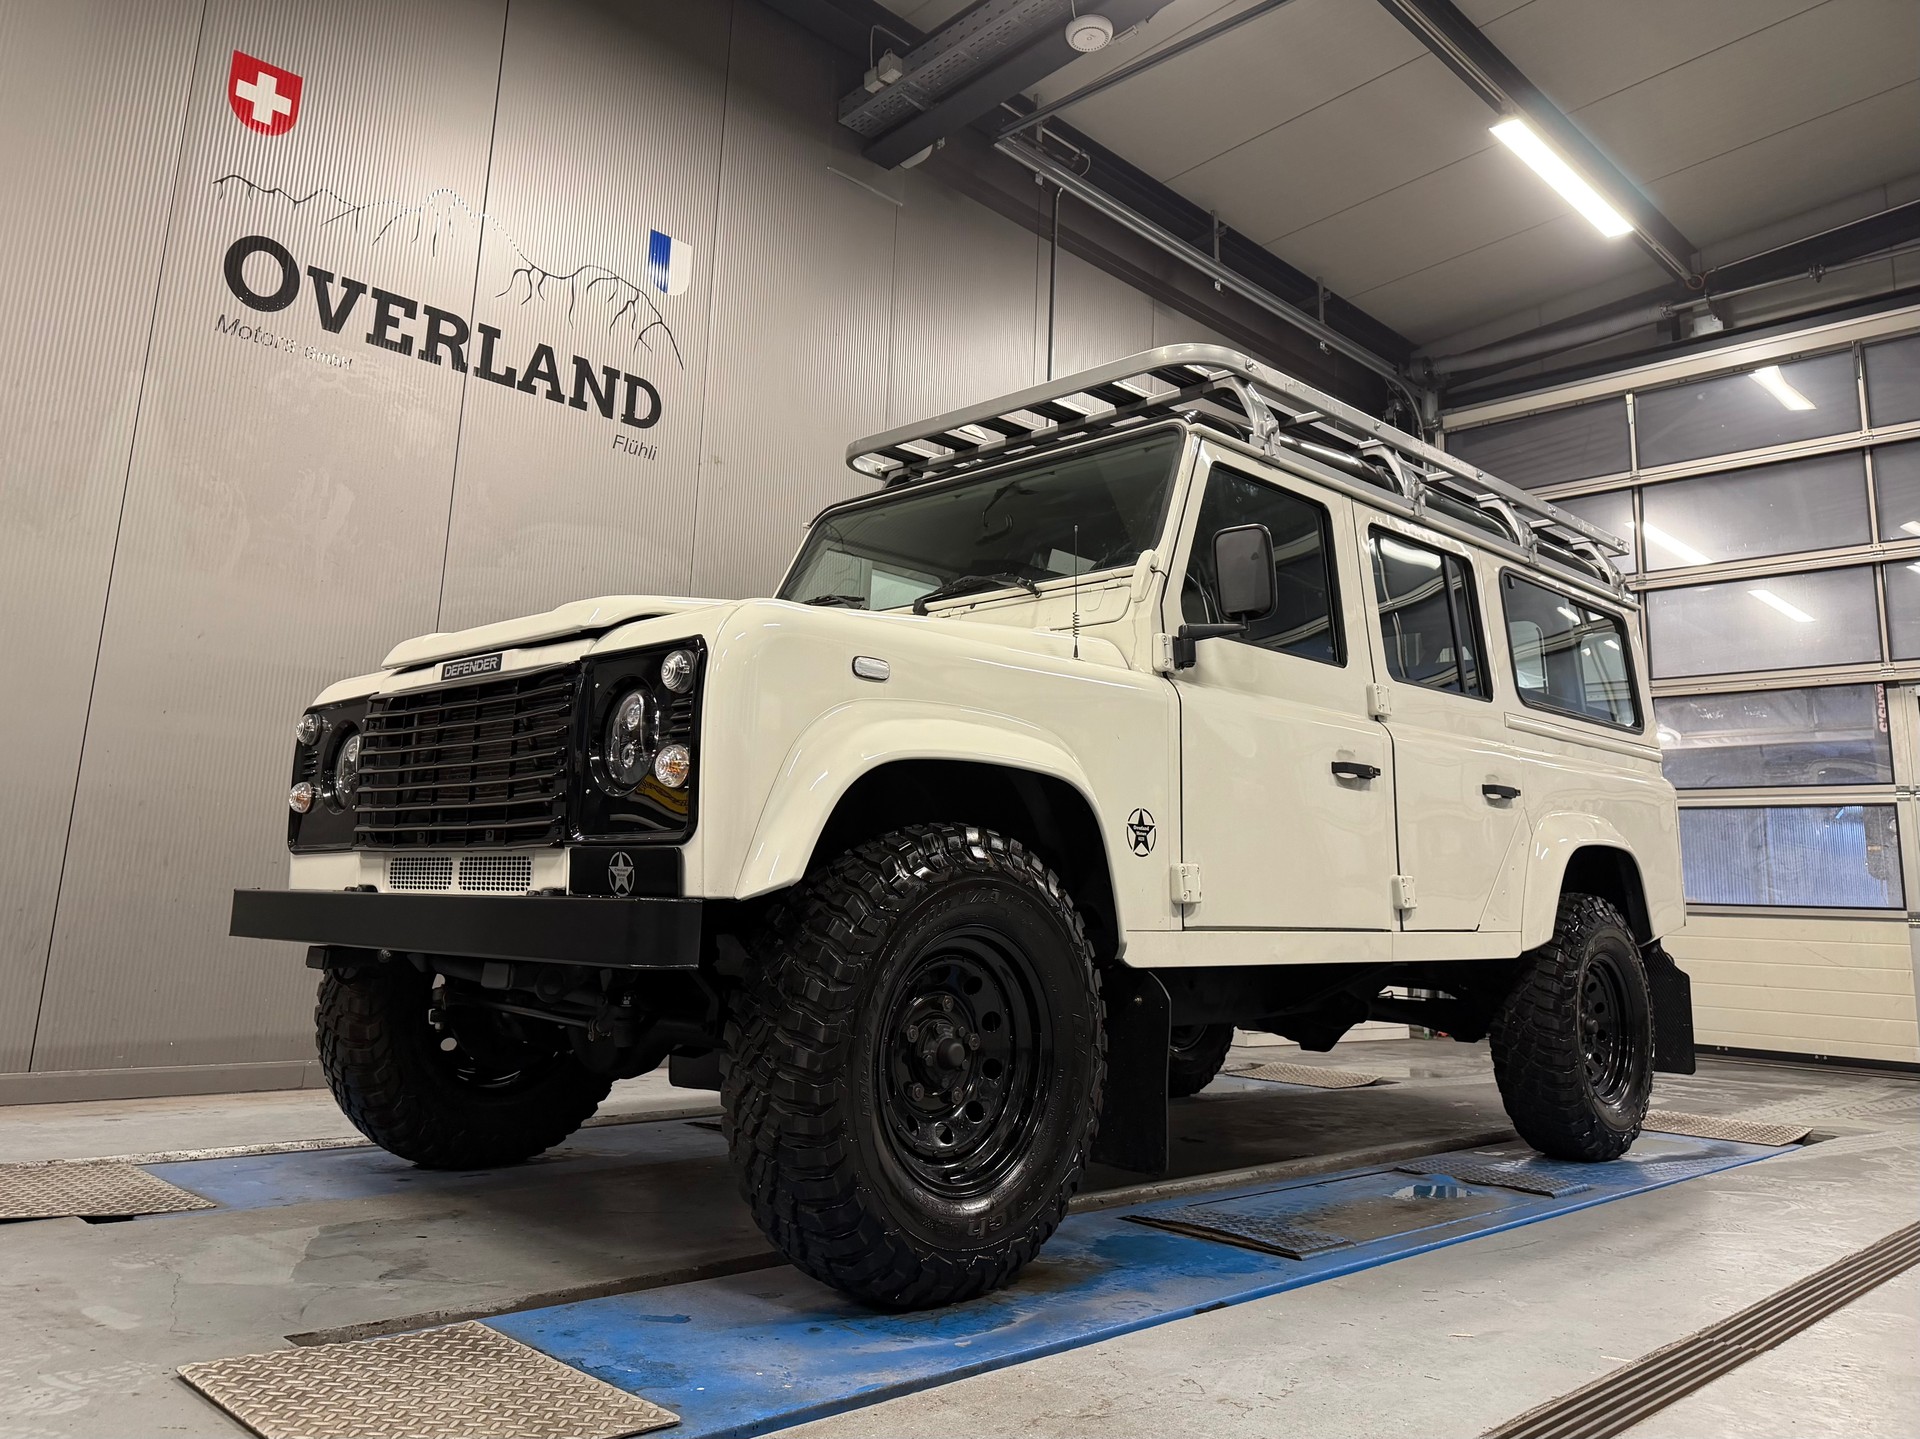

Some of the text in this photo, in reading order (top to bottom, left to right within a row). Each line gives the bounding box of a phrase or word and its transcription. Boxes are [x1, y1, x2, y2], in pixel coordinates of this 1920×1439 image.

[215, 314, 352, 370] Motors GmbH
[223, 234, 662, 429] OVERLAND
[612, 434, 658, 460] Flühli
[444, 656, 499, 678] DEFENDER
